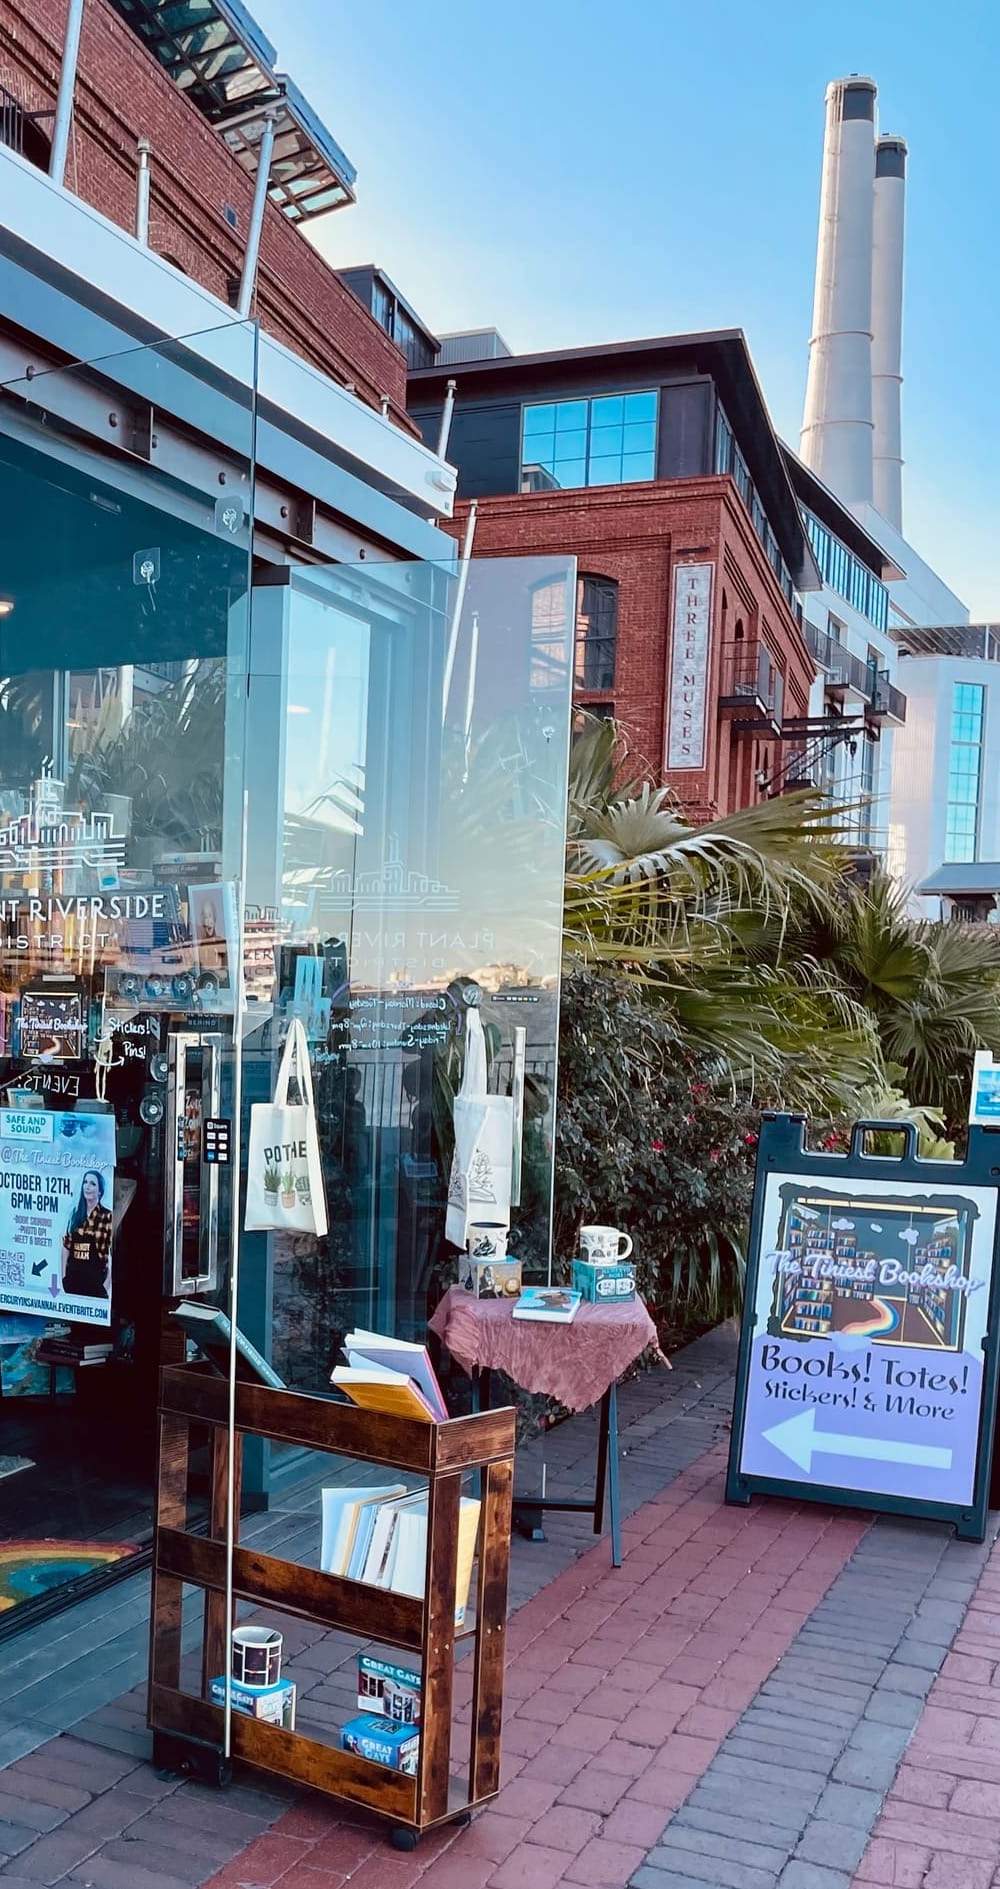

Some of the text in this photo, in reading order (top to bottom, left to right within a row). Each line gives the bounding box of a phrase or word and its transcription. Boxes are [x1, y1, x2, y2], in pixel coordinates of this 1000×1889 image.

[680, 577, 698, 755] THREE MUSES
[30, 894, 164, 921] RIVERSIDE
[108, 1017, 150, 1036] Stickers!
[122, 1041, 146, 1059] Pins!
[6, 1114, 46, 1126] SAFE AND
[11, 1124, 41, 1134] SOUND
[46, 1176, 73, 1197] 12TH,
[11, 1192, 59, 1214] 6PM-8PM
[765, 1250, 987, 1297] The Tiniest Bookshop
[761, 1344, 969, 1394] Books! Totes!
[764, 1377, 956, 1420] Stickers! & More
[362, 1657, 395, 1675] GREAT
[362, 1738, 393, 1754] GREAT
